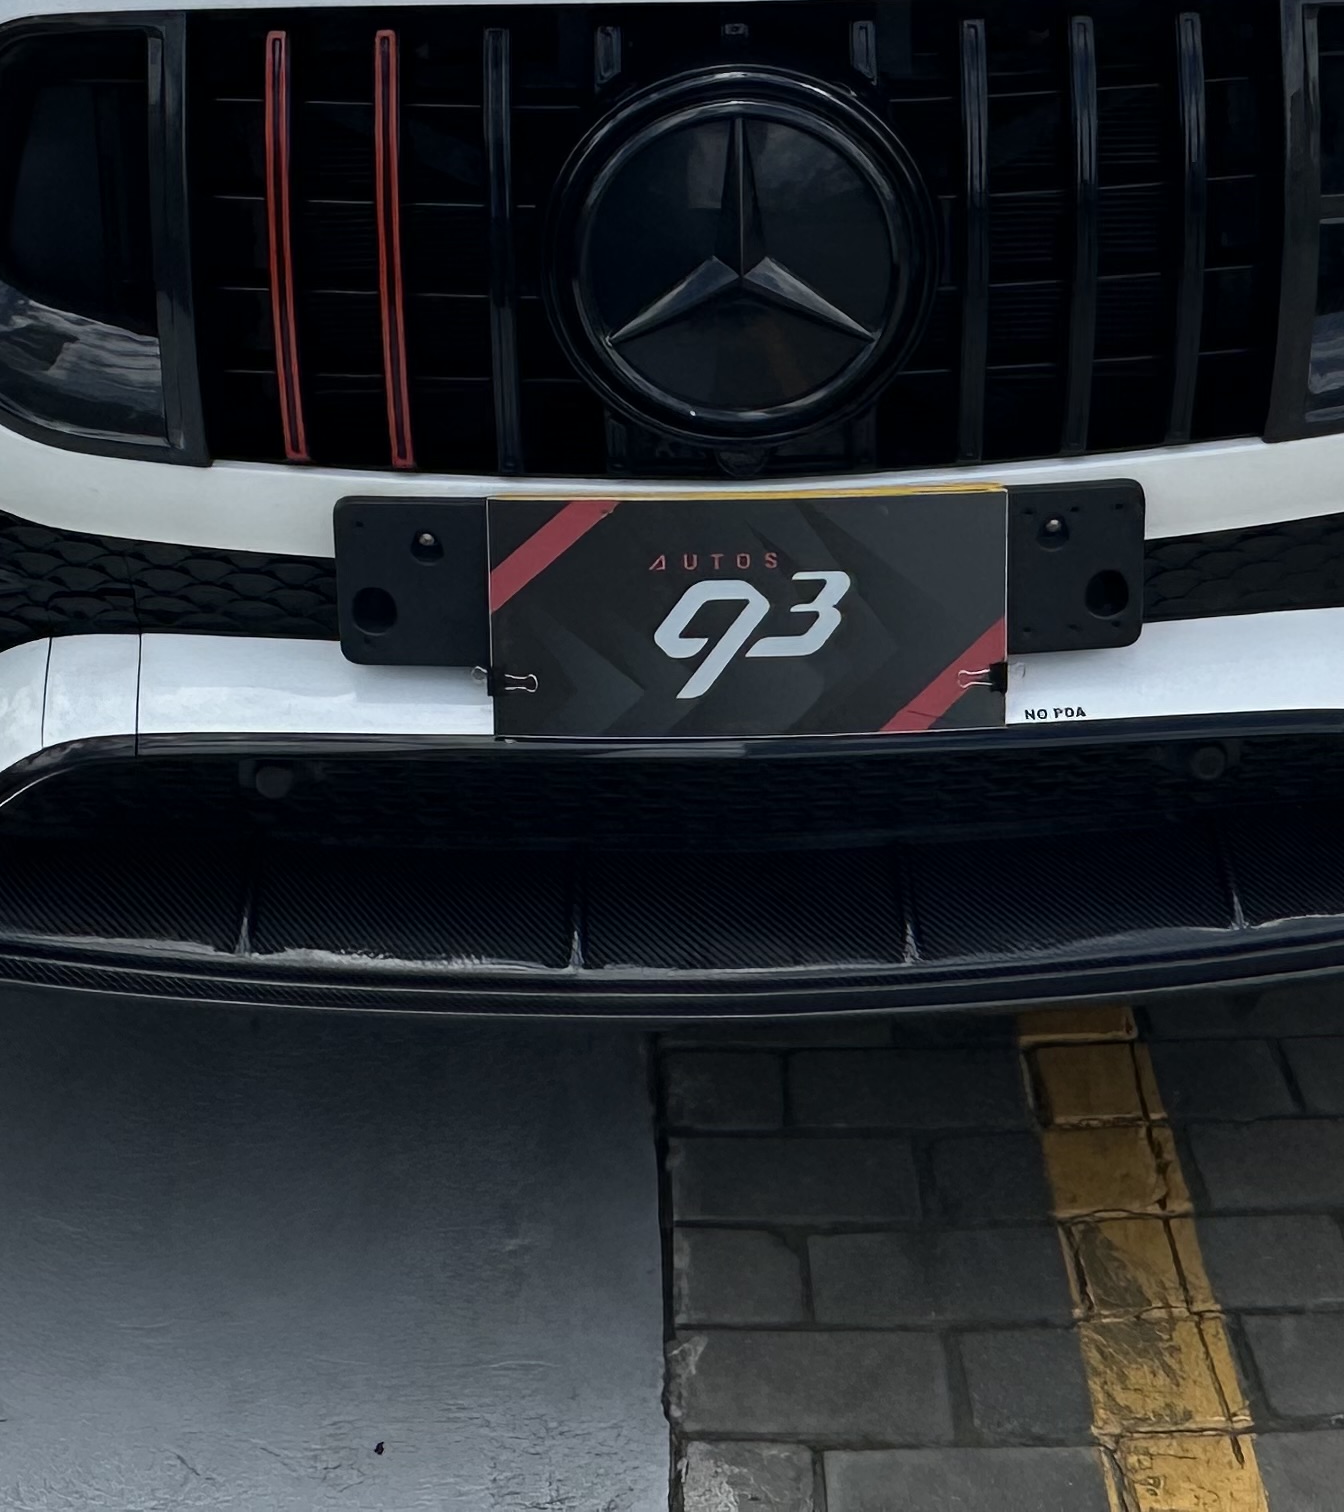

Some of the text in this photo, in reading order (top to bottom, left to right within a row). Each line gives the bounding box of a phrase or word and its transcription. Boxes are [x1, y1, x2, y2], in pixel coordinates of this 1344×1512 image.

[648, 552, 778, 571] AUTOS
[653, 570, 851, 700] 93
[1024, 708, 1048, 721] NO
